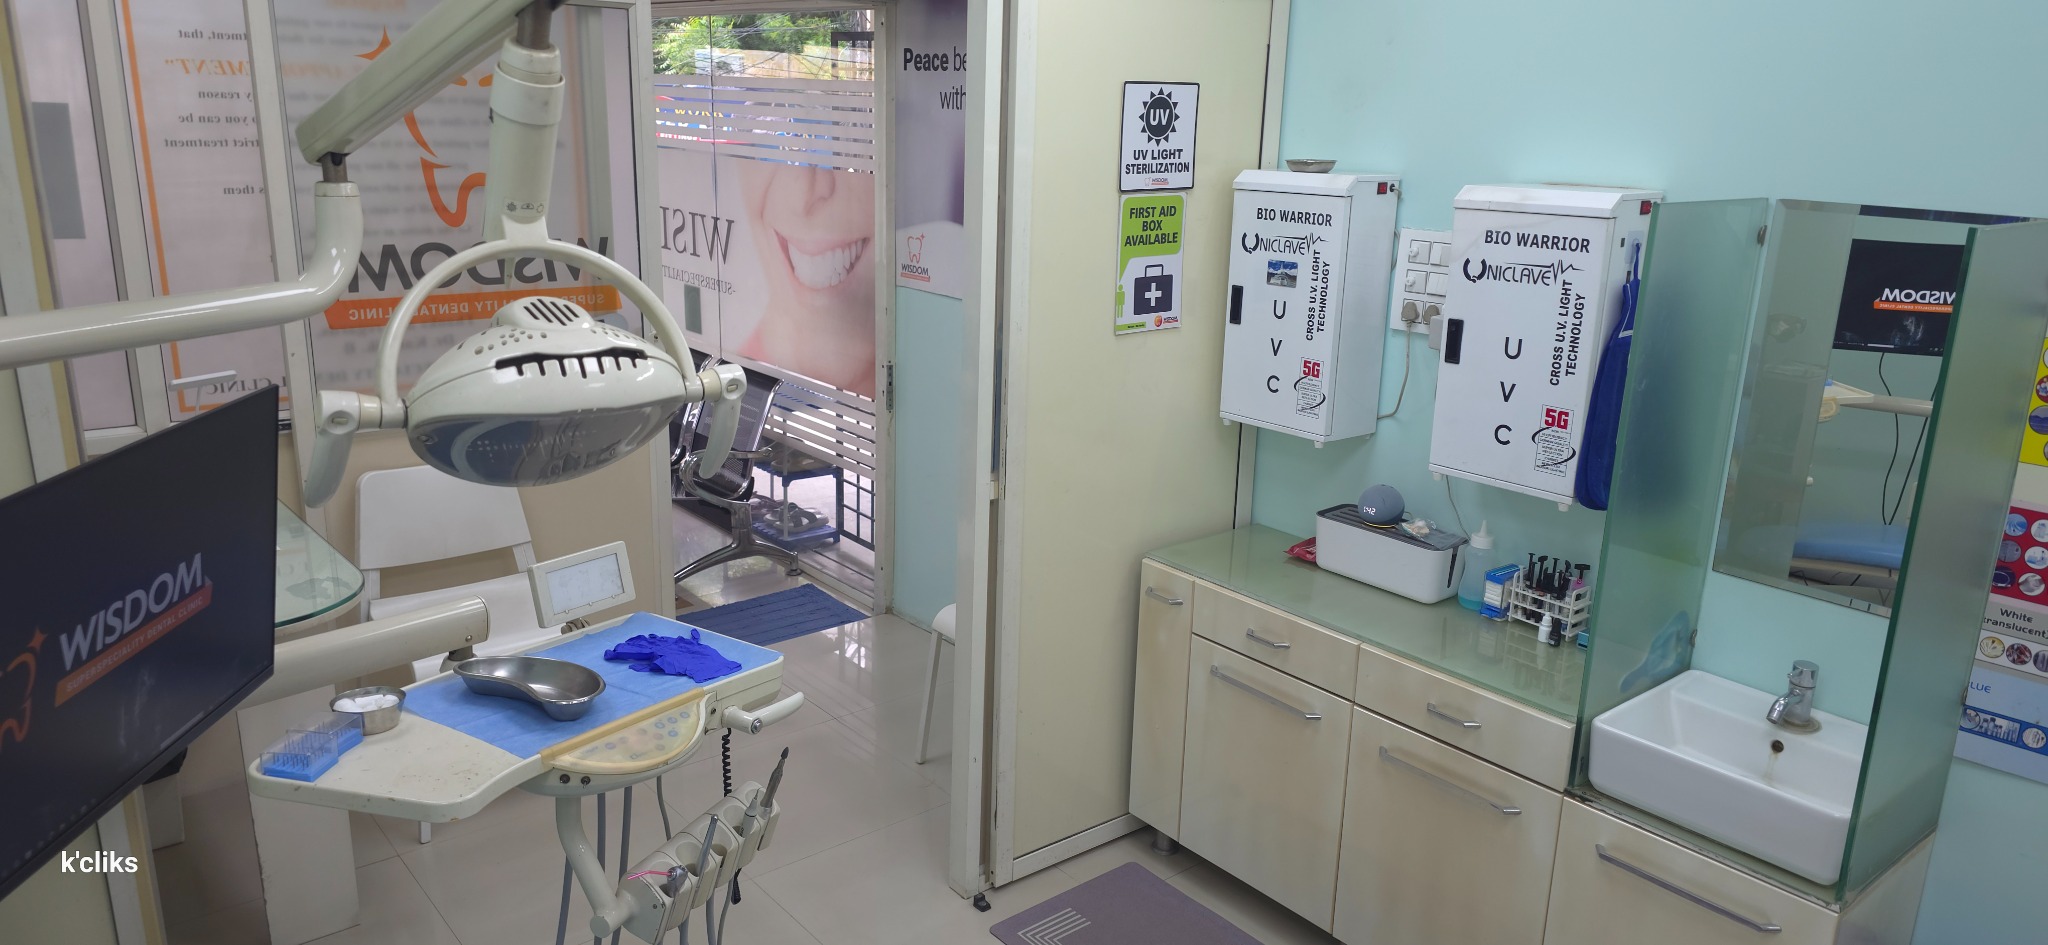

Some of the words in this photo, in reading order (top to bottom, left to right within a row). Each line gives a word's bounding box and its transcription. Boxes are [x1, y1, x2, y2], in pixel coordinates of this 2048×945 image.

[903, 47, 949, 71] Peace
[1149, 107, 1170, 126] UV
[1133, 149, 1149, 161] UV
[1151, 148, 1183, 160] LIGHT
[1125, 162, 1190, 175] STERILIZATION
[1129, 206, 1156, 219] FIRST
[1158, 205, 1177, 218] AID
[1256, 207, 1276, 222] BIO
[1279, 209, 1333, 227] WARRIOR
[1142, 219, 1163, 232] BOX
[1124, 232, 1179, 247] AVAILABLE
[1484, 229, 1511, 246] BIO
[1516, 232, 1590, 253] WARRIOR
[901, 263, 929, 276] WISDOM
[1310, 249, 1321, 284] LIGHT
[1316, 261, 1331, 333] TECHNOLOGY
[1305, 304, 1316, 341] CROSS
[1549, 346, 1565, 386] CROSS
[1559, 279, 1573, 317] LIGHT
[1564, 293, 1586, 377] TECHNOLOGY
[1302, 359, 1321, 379] 5G
[1544, 407, 1570, 431] 5G
[59, 552, 202, 671] WISDOM
[147, 616, 177, 639] DENTAL
[178, 596, 204, 618] CLINIC
[2000, 607, 2034, 624] White
